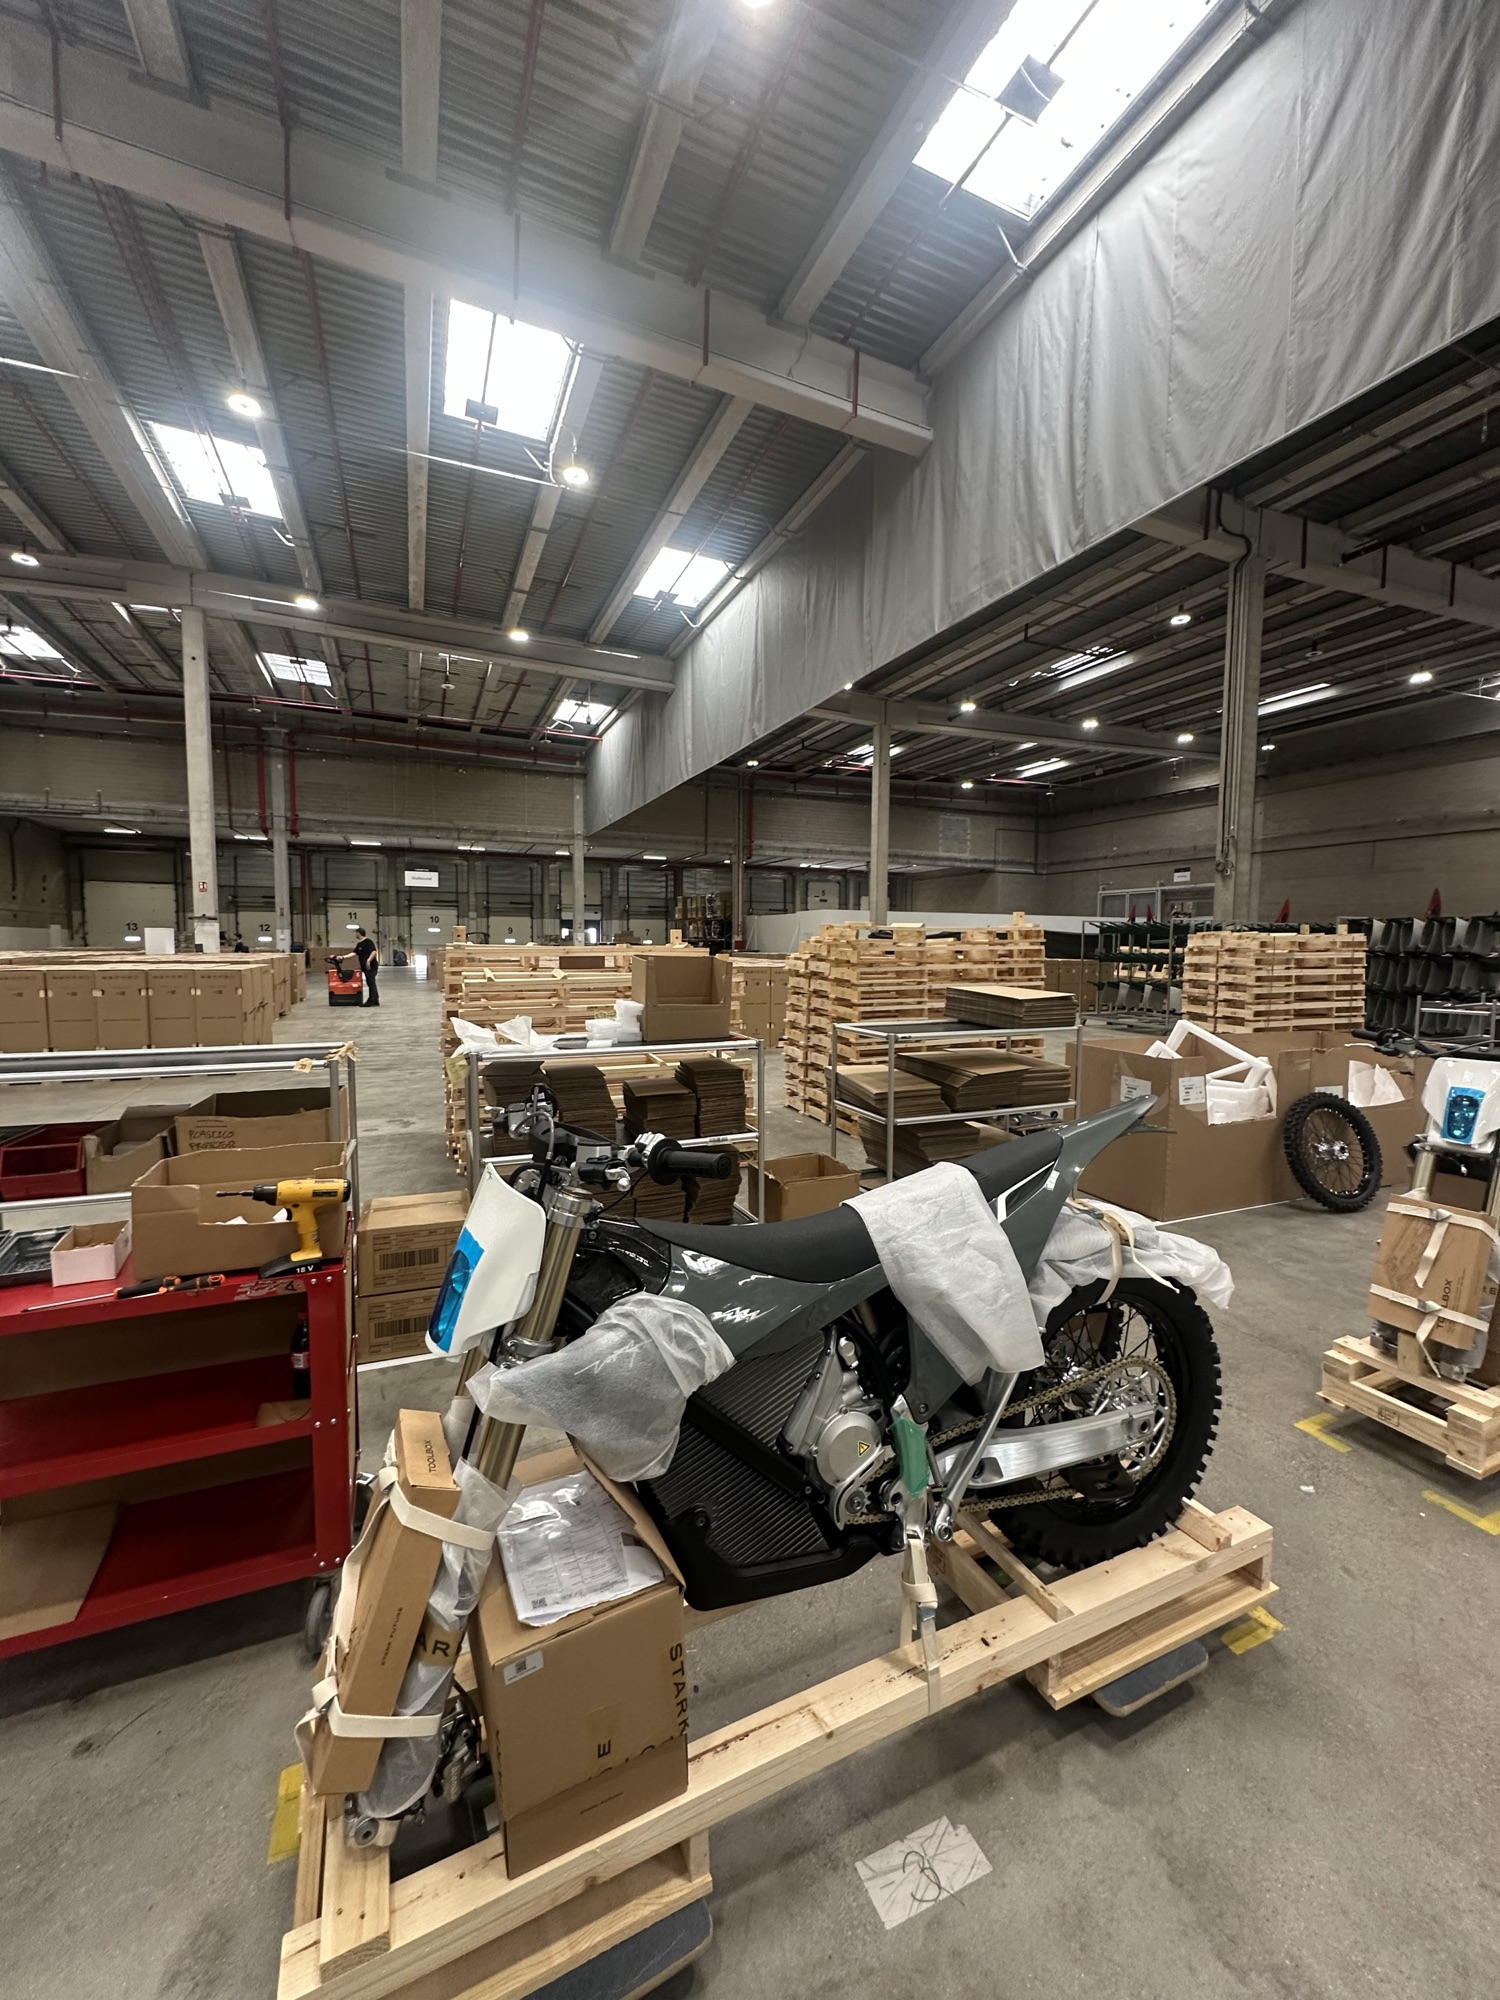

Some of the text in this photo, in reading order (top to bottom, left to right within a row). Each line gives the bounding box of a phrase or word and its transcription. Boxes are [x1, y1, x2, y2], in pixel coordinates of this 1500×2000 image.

[347, 911, 358, 920] 11
[429, 915, 440, 924] 10
[125, 922, 139, 931] 13
[258, 923, 271, 932] 12
[507, 927, 513, 935] 9
[645, 928, 651, 936] 7
[296, 1266, 306, 1274] 18
[424, 1439, 437, 1473] TOOLBOX
[669, 1642, 690, 1736] STARK
